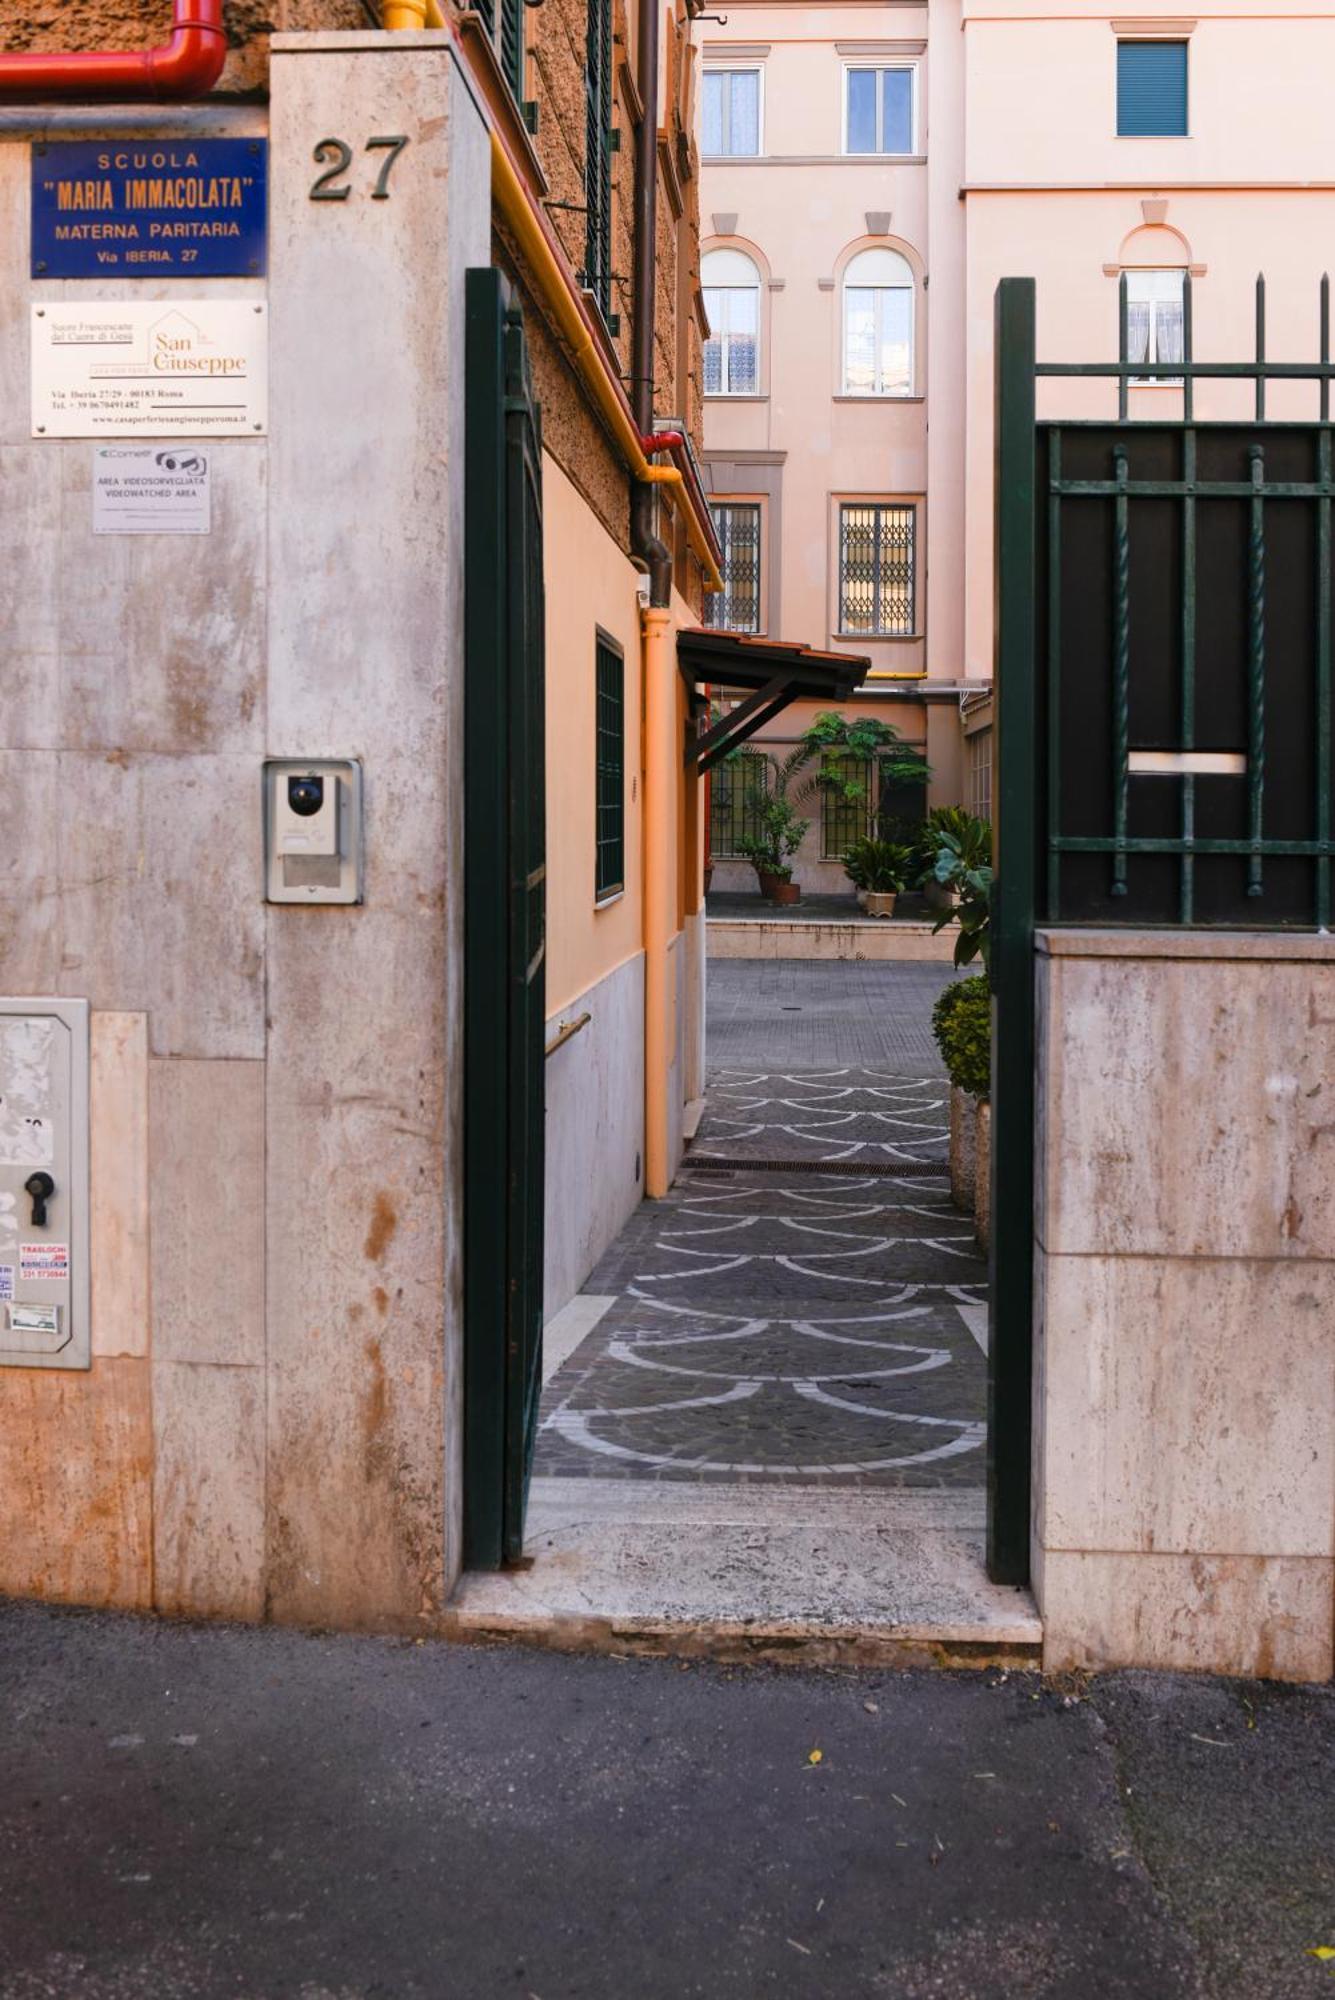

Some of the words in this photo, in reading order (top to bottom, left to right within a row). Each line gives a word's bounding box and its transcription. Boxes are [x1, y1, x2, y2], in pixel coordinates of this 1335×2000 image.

[98, 153, 198, 170] SCUOLA
[309, 136, 411, 201] 27
[55, 224, 139, 240] MATERNA
[150, 222, 240, 238] PARITARIA
[97, 252, 118, 263] Via
[181, 249, 197, 261] 27
[156, 333, 191, 351] San
[153, 352, 246, 374] Giuseppe
[51, 390, 66, 399] Via
[158, 388, 183, 398] Roma
[98, 478, 119, 486] AREA
[106, 489, 171, 498] VIDEOWATCHED
[176, 489, 197, 498] AREA
